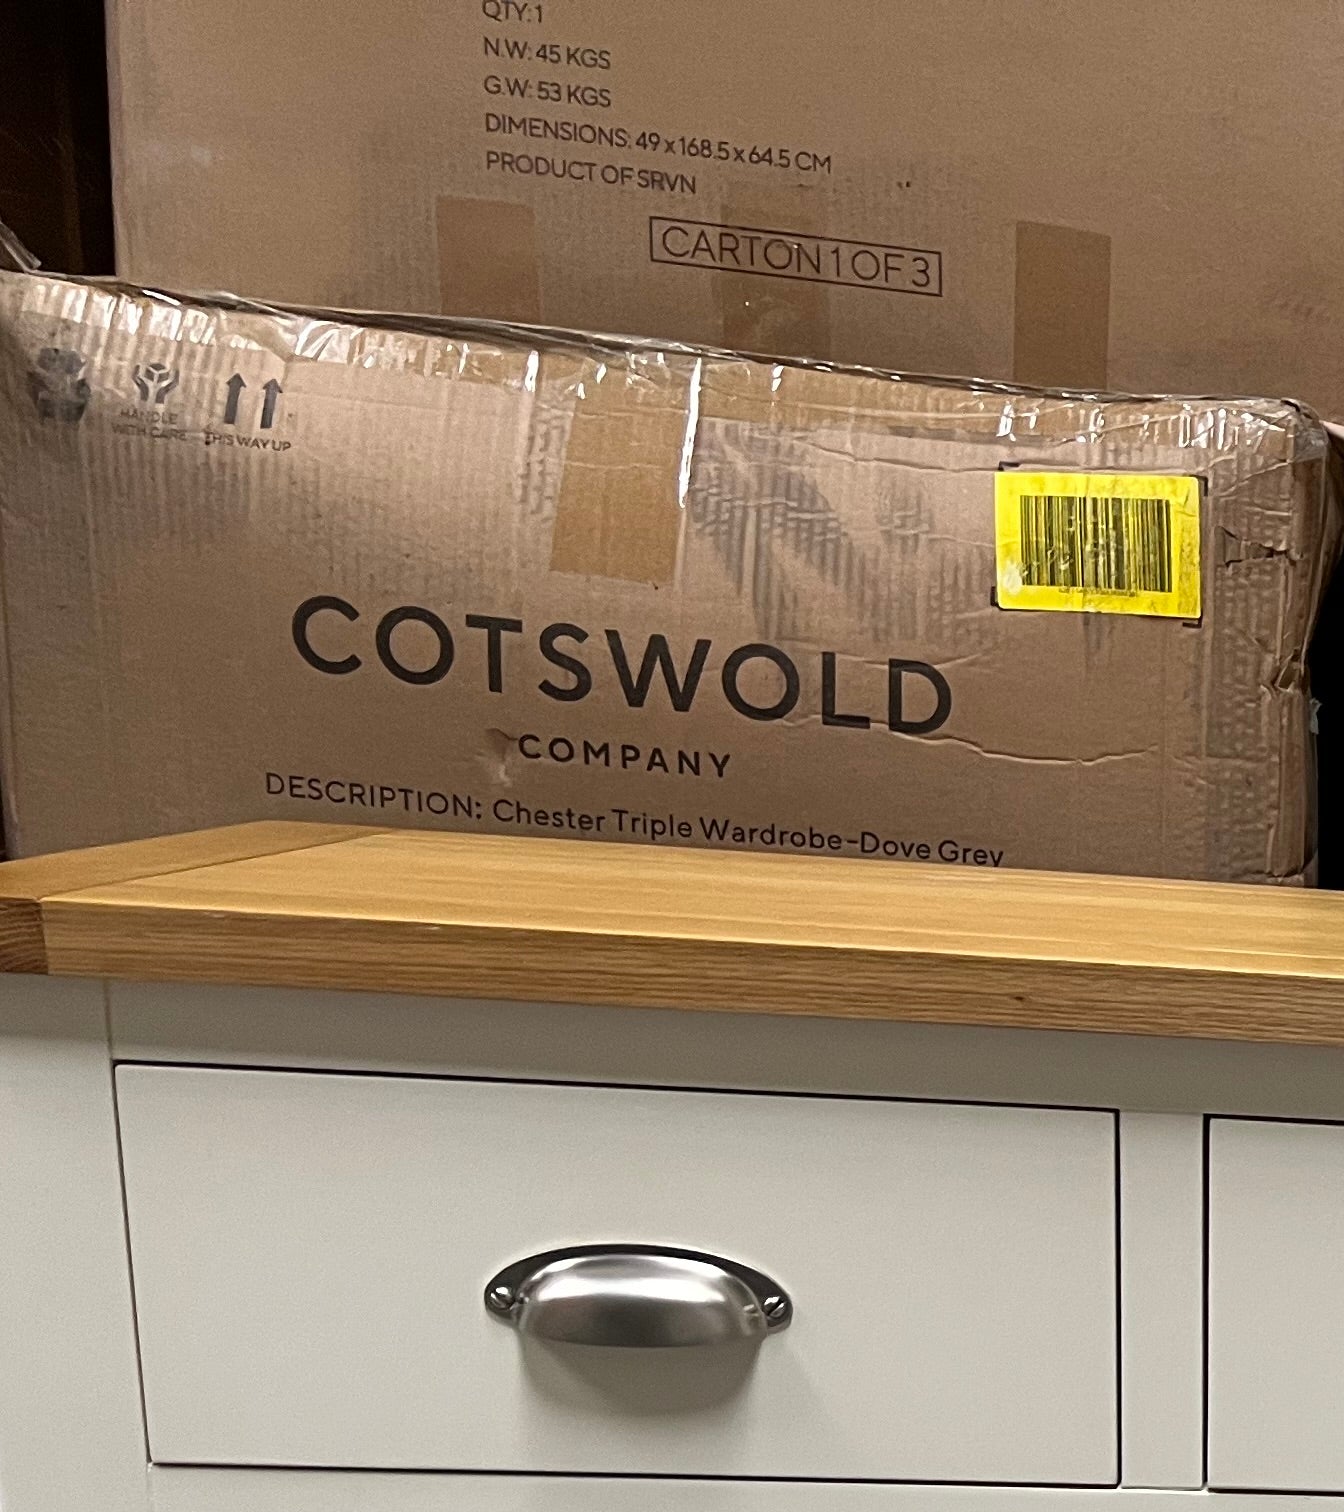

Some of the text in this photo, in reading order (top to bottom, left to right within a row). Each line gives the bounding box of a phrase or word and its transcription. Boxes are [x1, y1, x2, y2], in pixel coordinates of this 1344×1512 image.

[483, 36, 611, 70] N.W: 45 KGS
[483, 75, 612, 108] G.W: 53 KGS
[485, 112, 632, 149] DIMENSIONS:
[635, 131, 660, 151] 49
[679, 136, 730, 161] 168.5
[749, 146, 790, 168] 64.5
[795, 151, 832, 174] CM
[486, 151, 697, 194] PRODUCT OF SRVN
[662, 226, 930, 287] CARTON 1 OF 3
[204, 430, 292, 451] THIS WAY UP
[291, 594, 953, 736] COTSWOLD
[518, 733, 732, 779] COMPANY
[265, 772, 483, 820] DESCRIPTION:
[493, 798, 606, 834] Chester
[611, 808, 693, 841] Triple
[700, 816, 931, 860] Wardrobe-Dove
